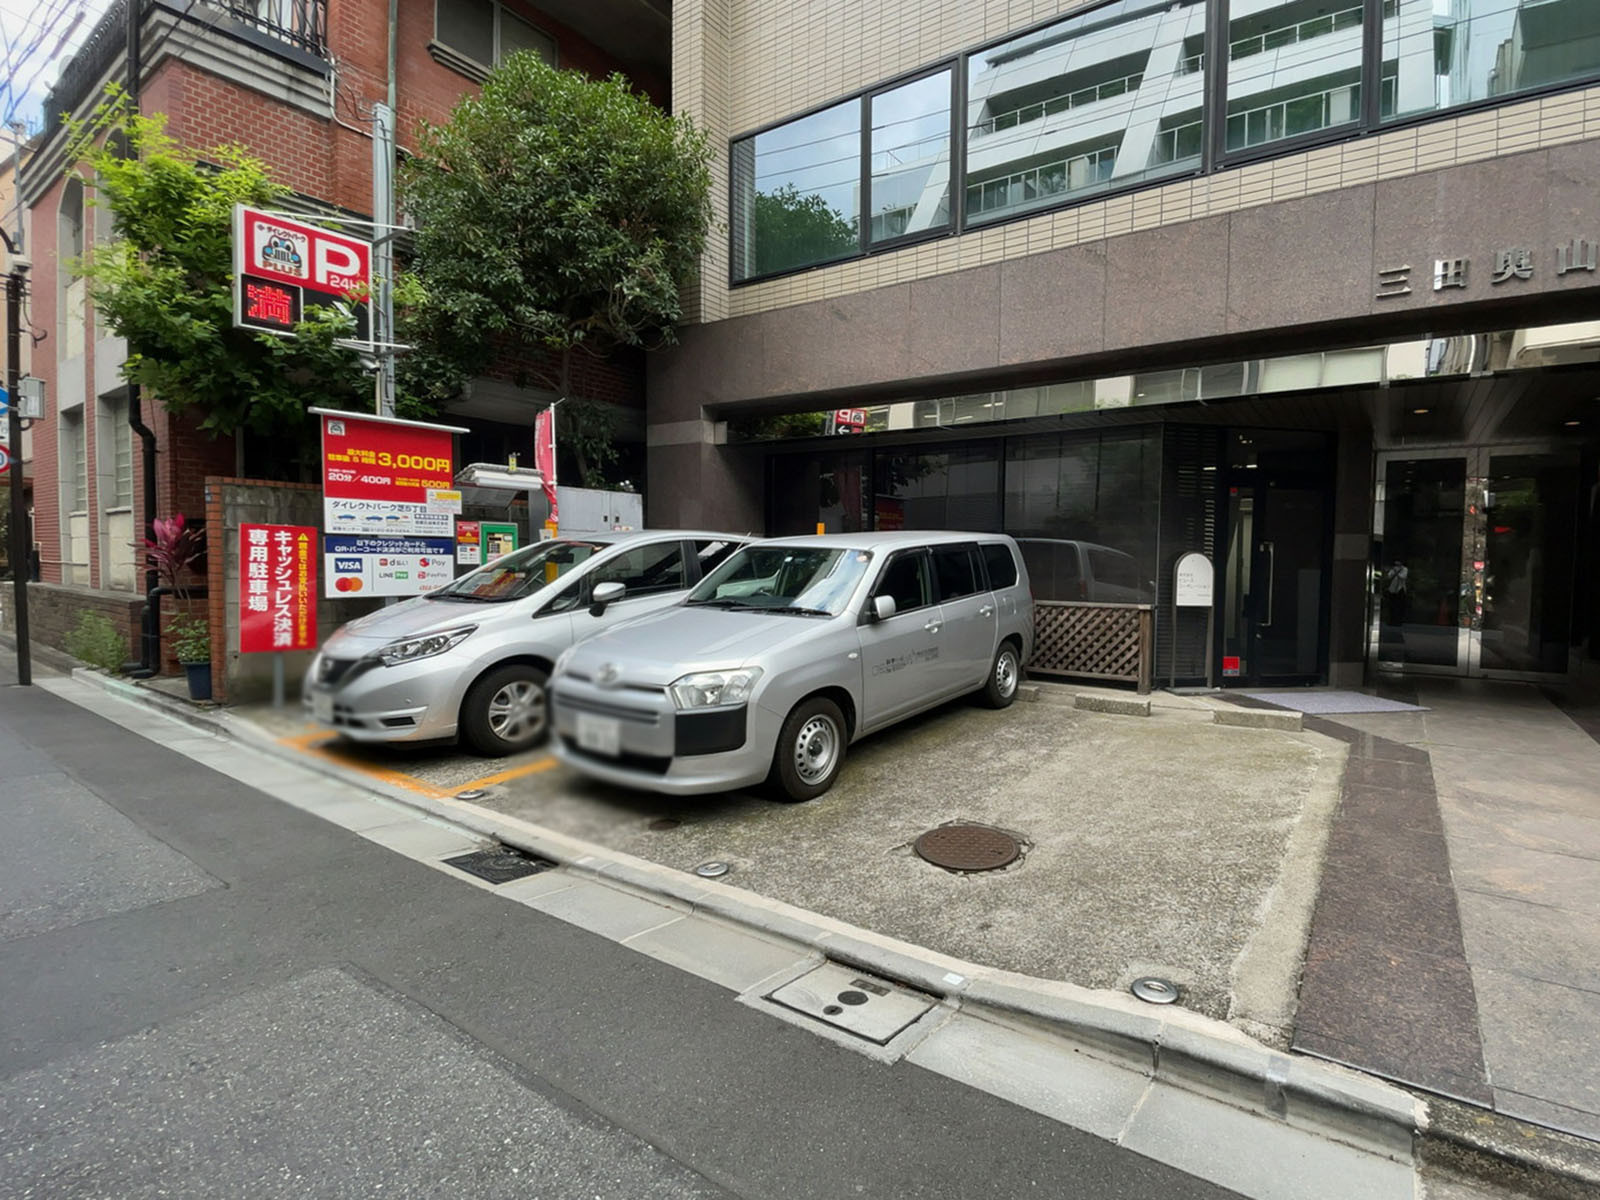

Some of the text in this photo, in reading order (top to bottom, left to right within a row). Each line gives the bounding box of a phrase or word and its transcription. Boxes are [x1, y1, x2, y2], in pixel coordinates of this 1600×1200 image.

[262, 260, 303, 278] PLUS
[314, 237, 361, 284] P
[1376, 239, 1599, 298] 三田奥山
[247, 284, 291, 324] 満
[378, 452, 450, 473] 3,000円
[248, 529, 269, 612] 専用駐車場
[337, 561, 361, 570] VISA
[431, 558, 447, 567] Pay
[273, 530, 293, 647] キャッシュレス決済
